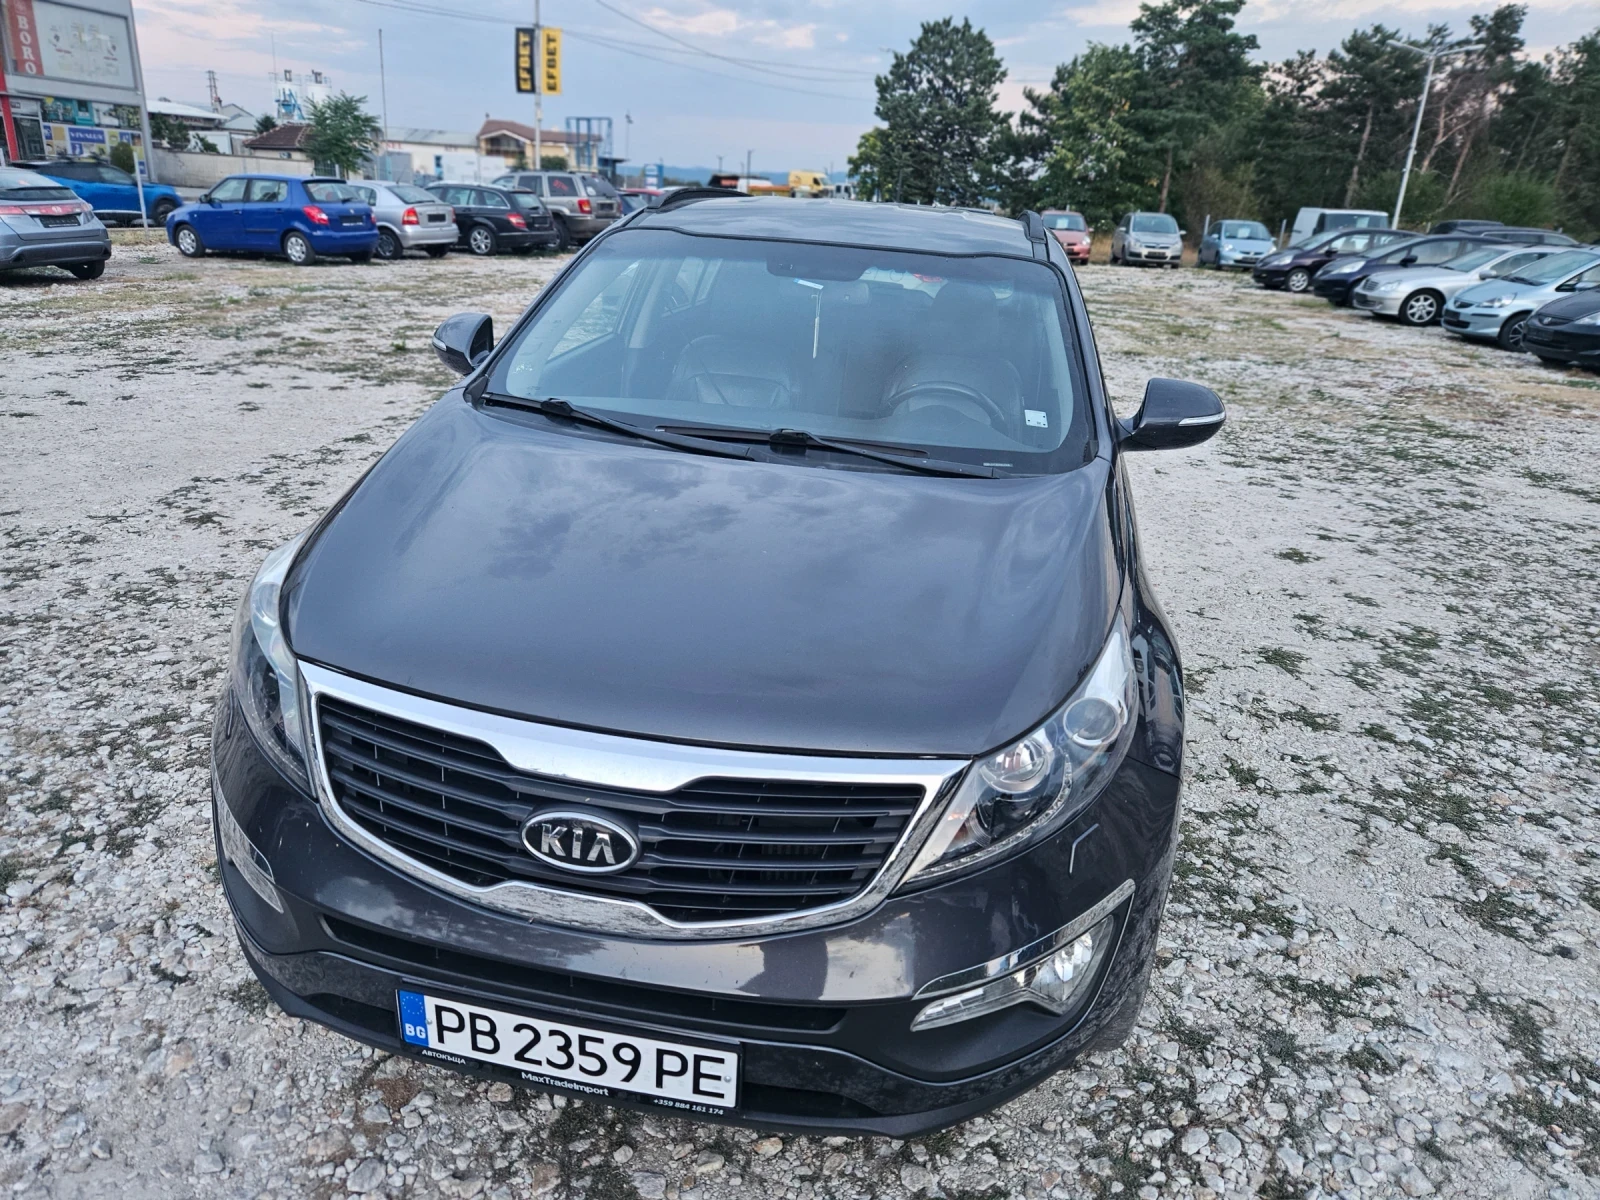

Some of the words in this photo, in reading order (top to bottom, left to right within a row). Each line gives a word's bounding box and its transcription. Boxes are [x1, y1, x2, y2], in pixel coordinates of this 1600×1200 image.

[16, 15, 37, 75] BORO
[546, 33, 557, 91] EFBET
[541, 823, 616, 865] KIA
[405, 1023, 427, 1040] BG
[422, 1049, 467, 1066] АВТОКЪЩА
[434, 1003, 500, 1055] PB
[512, 1022, 642, 1083] 2359
[655, 1047, 725, 1099] PE
[521, 1072, 609, 1097] MaxTradeImport
[653, 1099, 674, 1107] +359
[674, 1102, 690, 1110] 884
[691, 1104, 707, 1112] 161
[708, 1107, 724, 1116] 174
